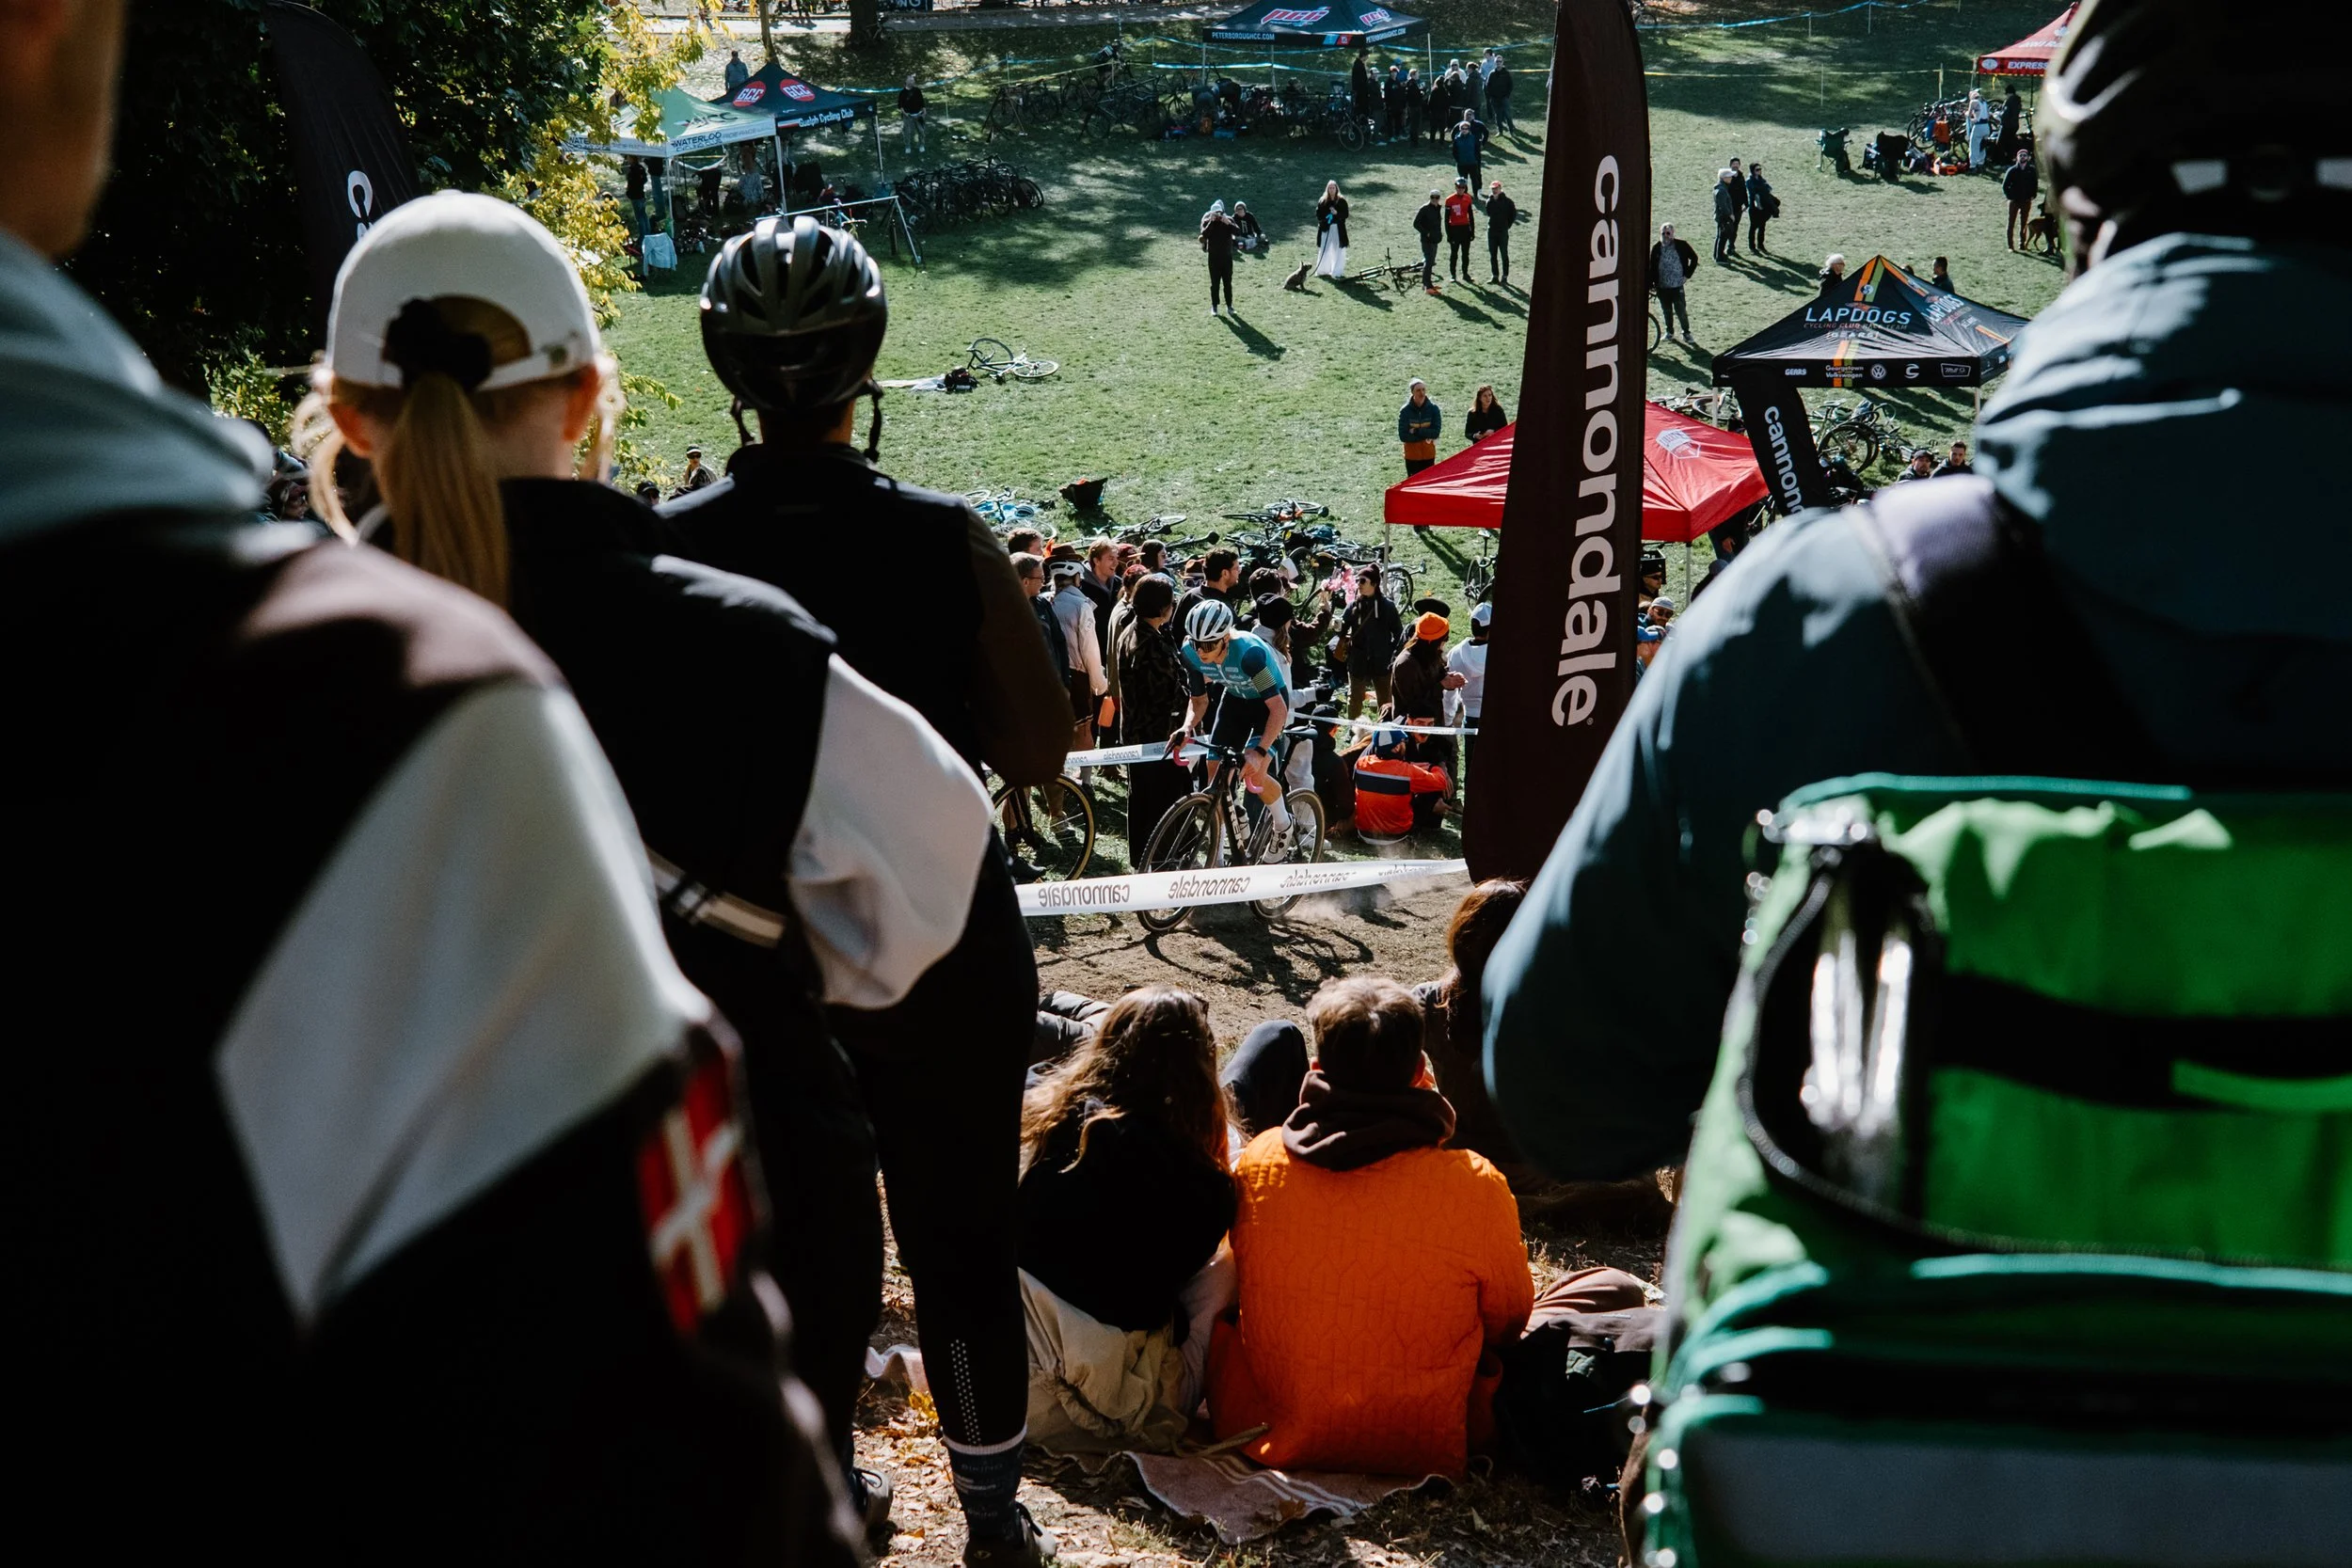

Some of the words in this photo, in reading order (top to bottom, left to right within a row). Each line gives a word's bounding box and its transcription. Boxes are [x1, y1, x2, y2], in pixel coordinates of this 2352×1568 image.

[737, 87, 765, 100] GCC
[783, 84, 813, 99] GCC
[799, 115, 819, 127] Guelph
[818, 111, 841, 124] Cycling
[840, 108, 854, 119] Club
[673, 132, 723, 148] WATERLOO
[1804, 307, 1912, 325] LAPDOGS
[1785, 368, 1806, 376] GEARS
[1552, 154, 1621, 726] cannondale
[1226, 795, 1245, 849] TREK
